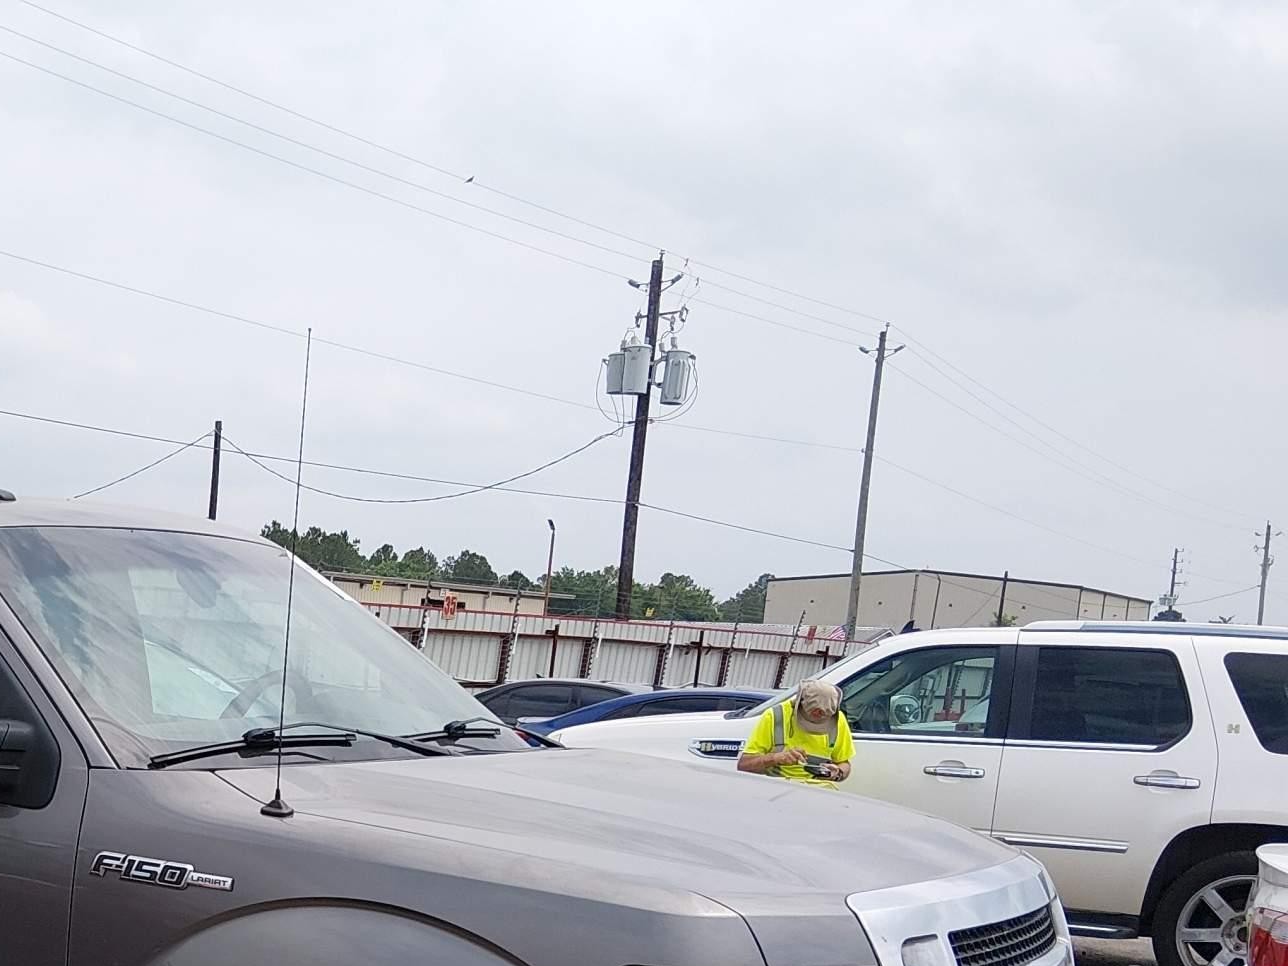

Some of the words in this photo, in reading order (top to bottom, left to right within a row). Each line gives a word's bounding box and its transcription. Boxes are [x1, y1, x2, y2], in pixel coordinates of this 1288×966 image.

[444, 595, 457, 616] 35
[90, 850, 194, 888] F-150
[190, 874, 229, 887] LARIAT
